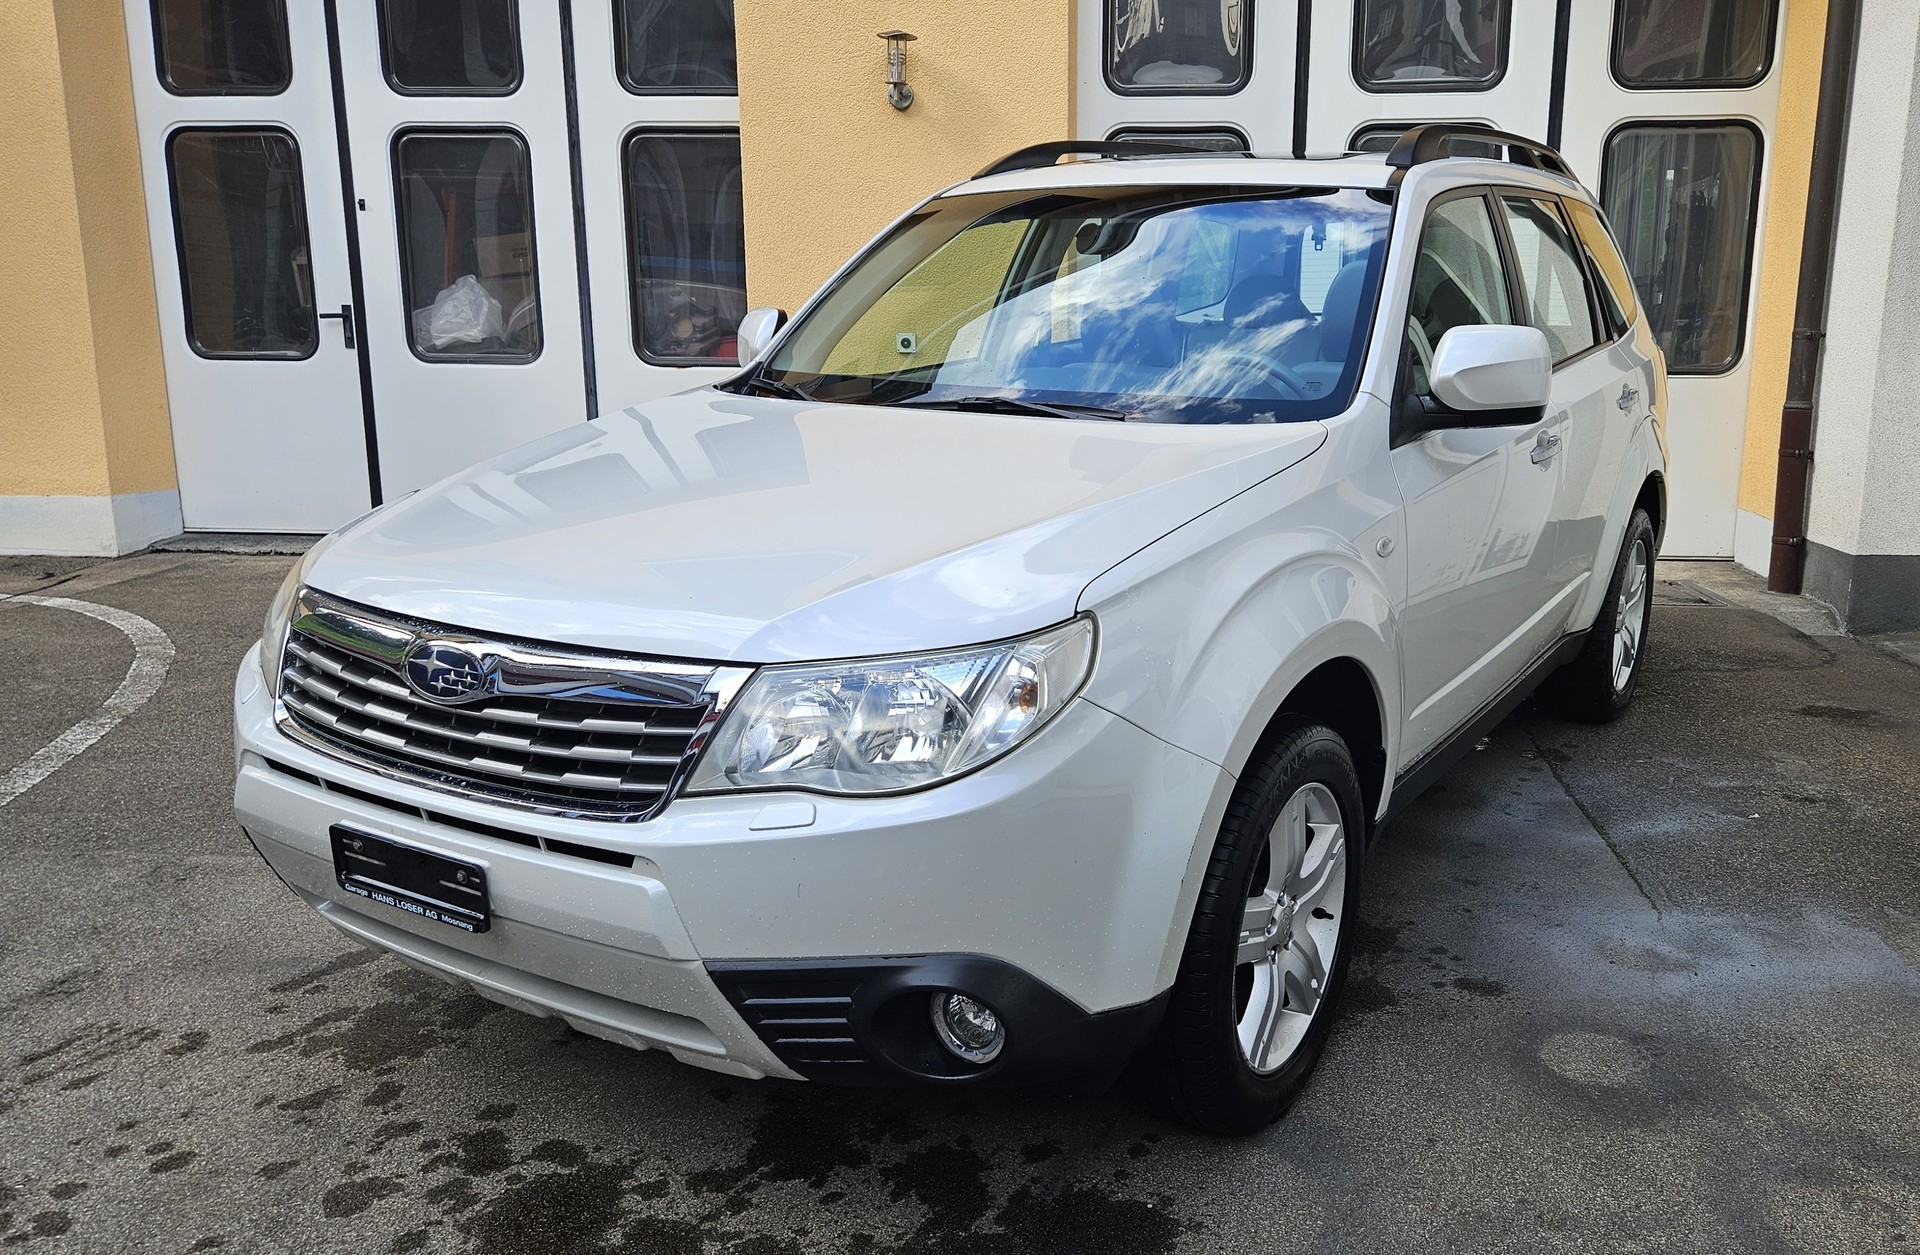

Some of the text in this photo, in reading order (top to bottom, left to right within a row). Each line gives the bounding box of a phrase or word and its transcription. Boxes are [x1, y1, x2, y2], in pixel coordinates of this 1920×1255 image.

[345, 883, 473, 932] Garage HANS LOSER AG Mosnang
